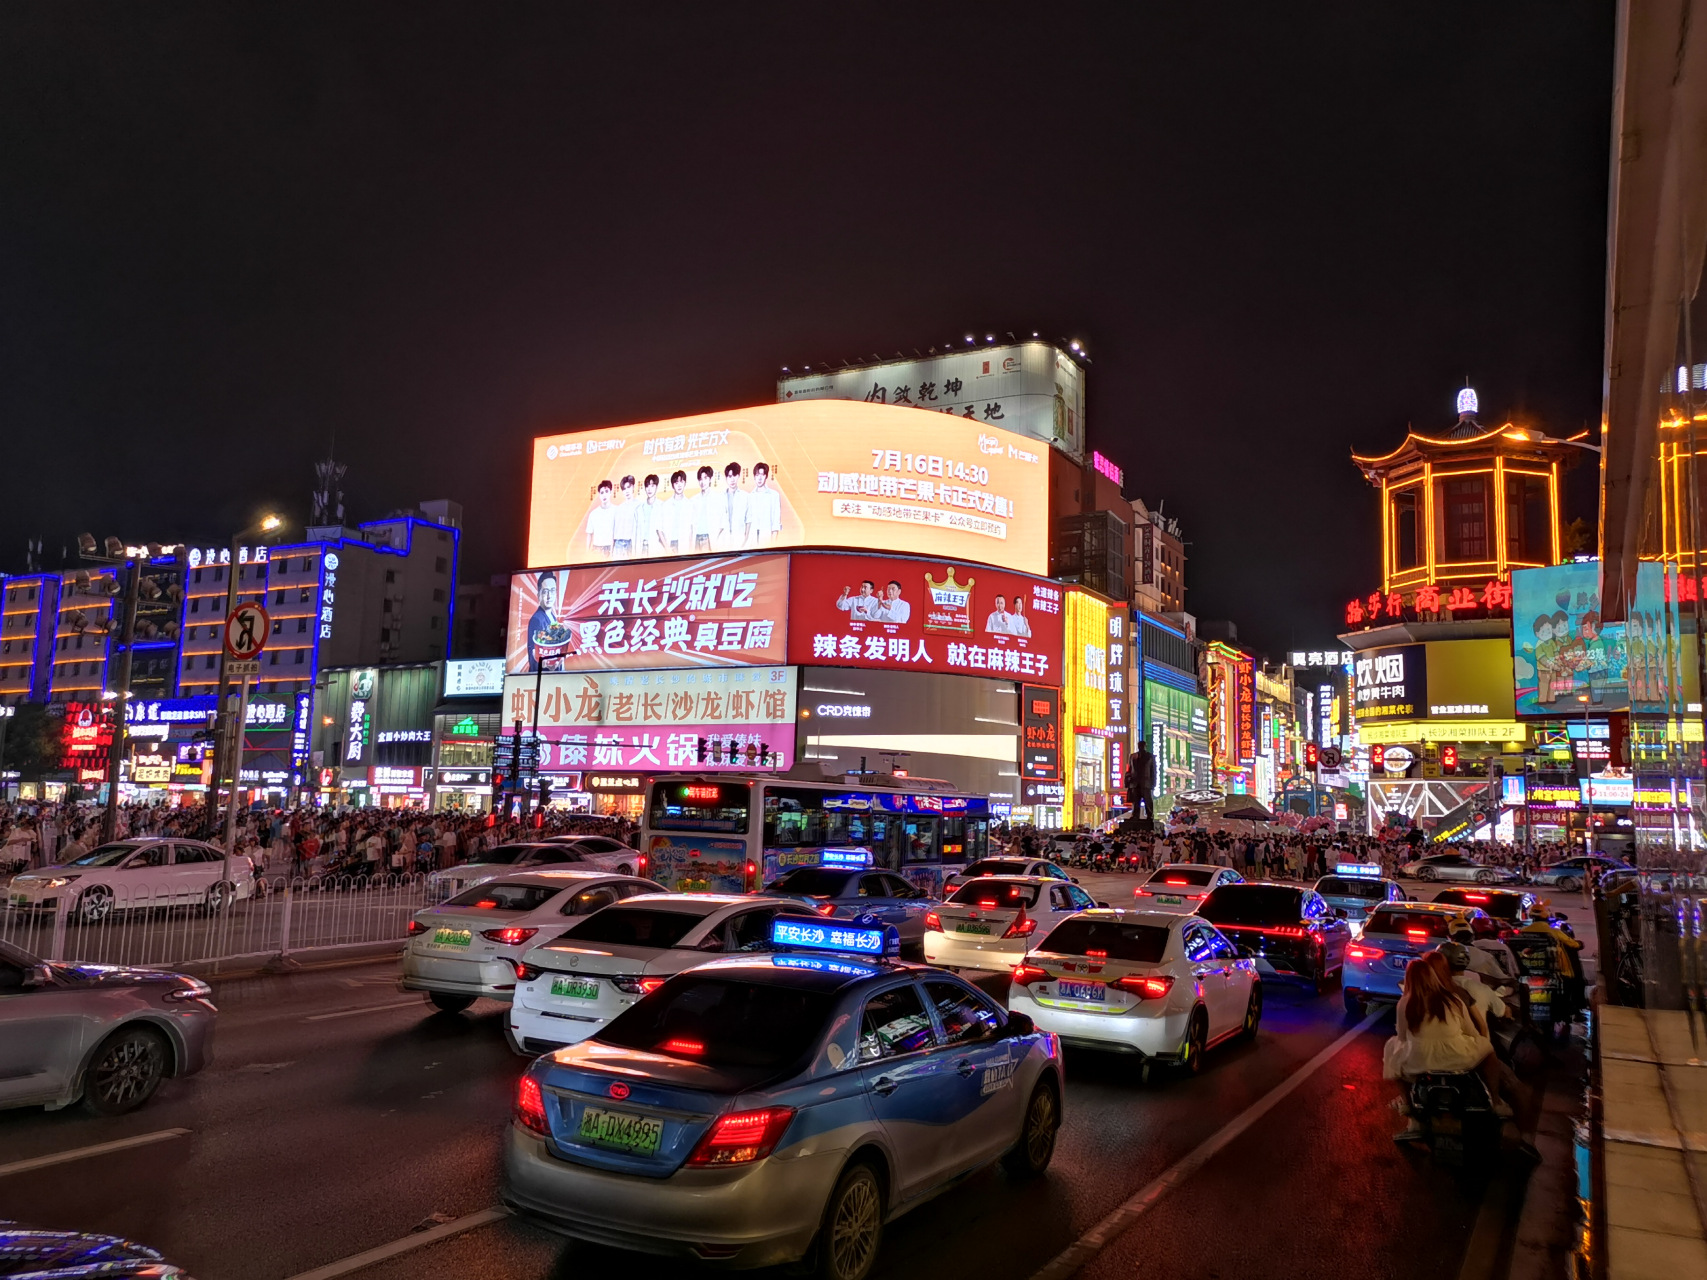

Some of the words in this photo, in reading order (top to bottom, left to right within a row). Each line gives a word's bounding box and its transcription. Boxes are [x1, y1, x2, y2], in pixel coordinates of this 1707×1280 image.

[321, 573, 337, 638] 漫心酒店
[598, 572, 758, 616] 来长沙就吃
[935, 592, 966, 605] 麻辣王子
[228, 663, 258, 673] 电子抓拍
[813, 634, 933, 664] 辣条发明人
[947, 642, 1049, 677] 就在麻辣王子
[1109, 616, 1124, 720] 明牌珠宝
[1356, 654, 1404, 687] 炊烟
[770, 670, 785, 683] 3F
[1239, 661, 1252, 702] 虾小龙
[511, 684, 602, 723] 虾小龙
[347, 701, 365, 760] 费大厨
[1026, 723, 1056, 741] 虾小龙
[1502, 727, 1515, 737] 2F
[559, 733, 699, 767] 傣妹火锅
[776, 925, 824, 944] 平安长沙
[830, 930, 881, 950] 幸福长沙
